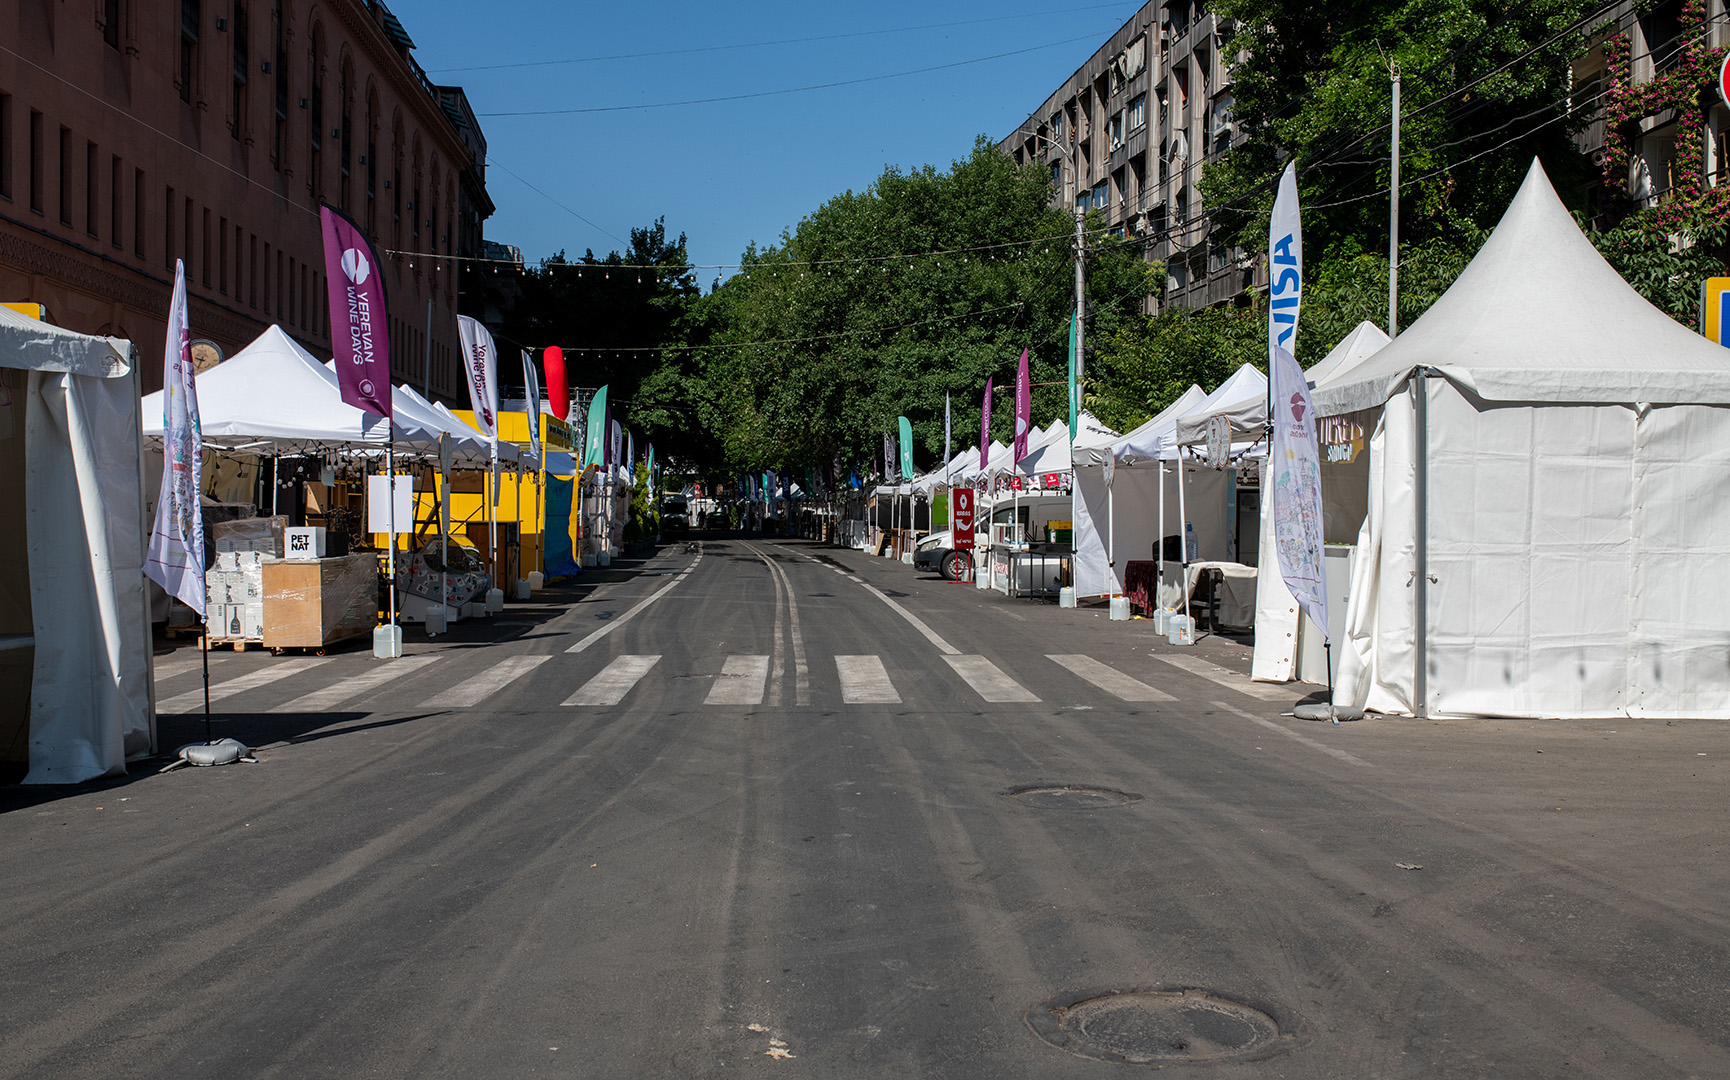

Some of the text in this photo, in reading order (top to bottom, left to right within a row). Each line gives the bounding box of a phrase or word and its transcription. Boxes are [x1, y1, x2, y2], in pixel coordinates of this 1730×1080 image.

[347, 286, 364, 365] WINE DAYS
[1271, 233, 1299, 347] VISA
[357, 292, 375, 363] YEREVAN
[290, 534, 310, 543] PET
[290, 542, 310, 551] NAT
